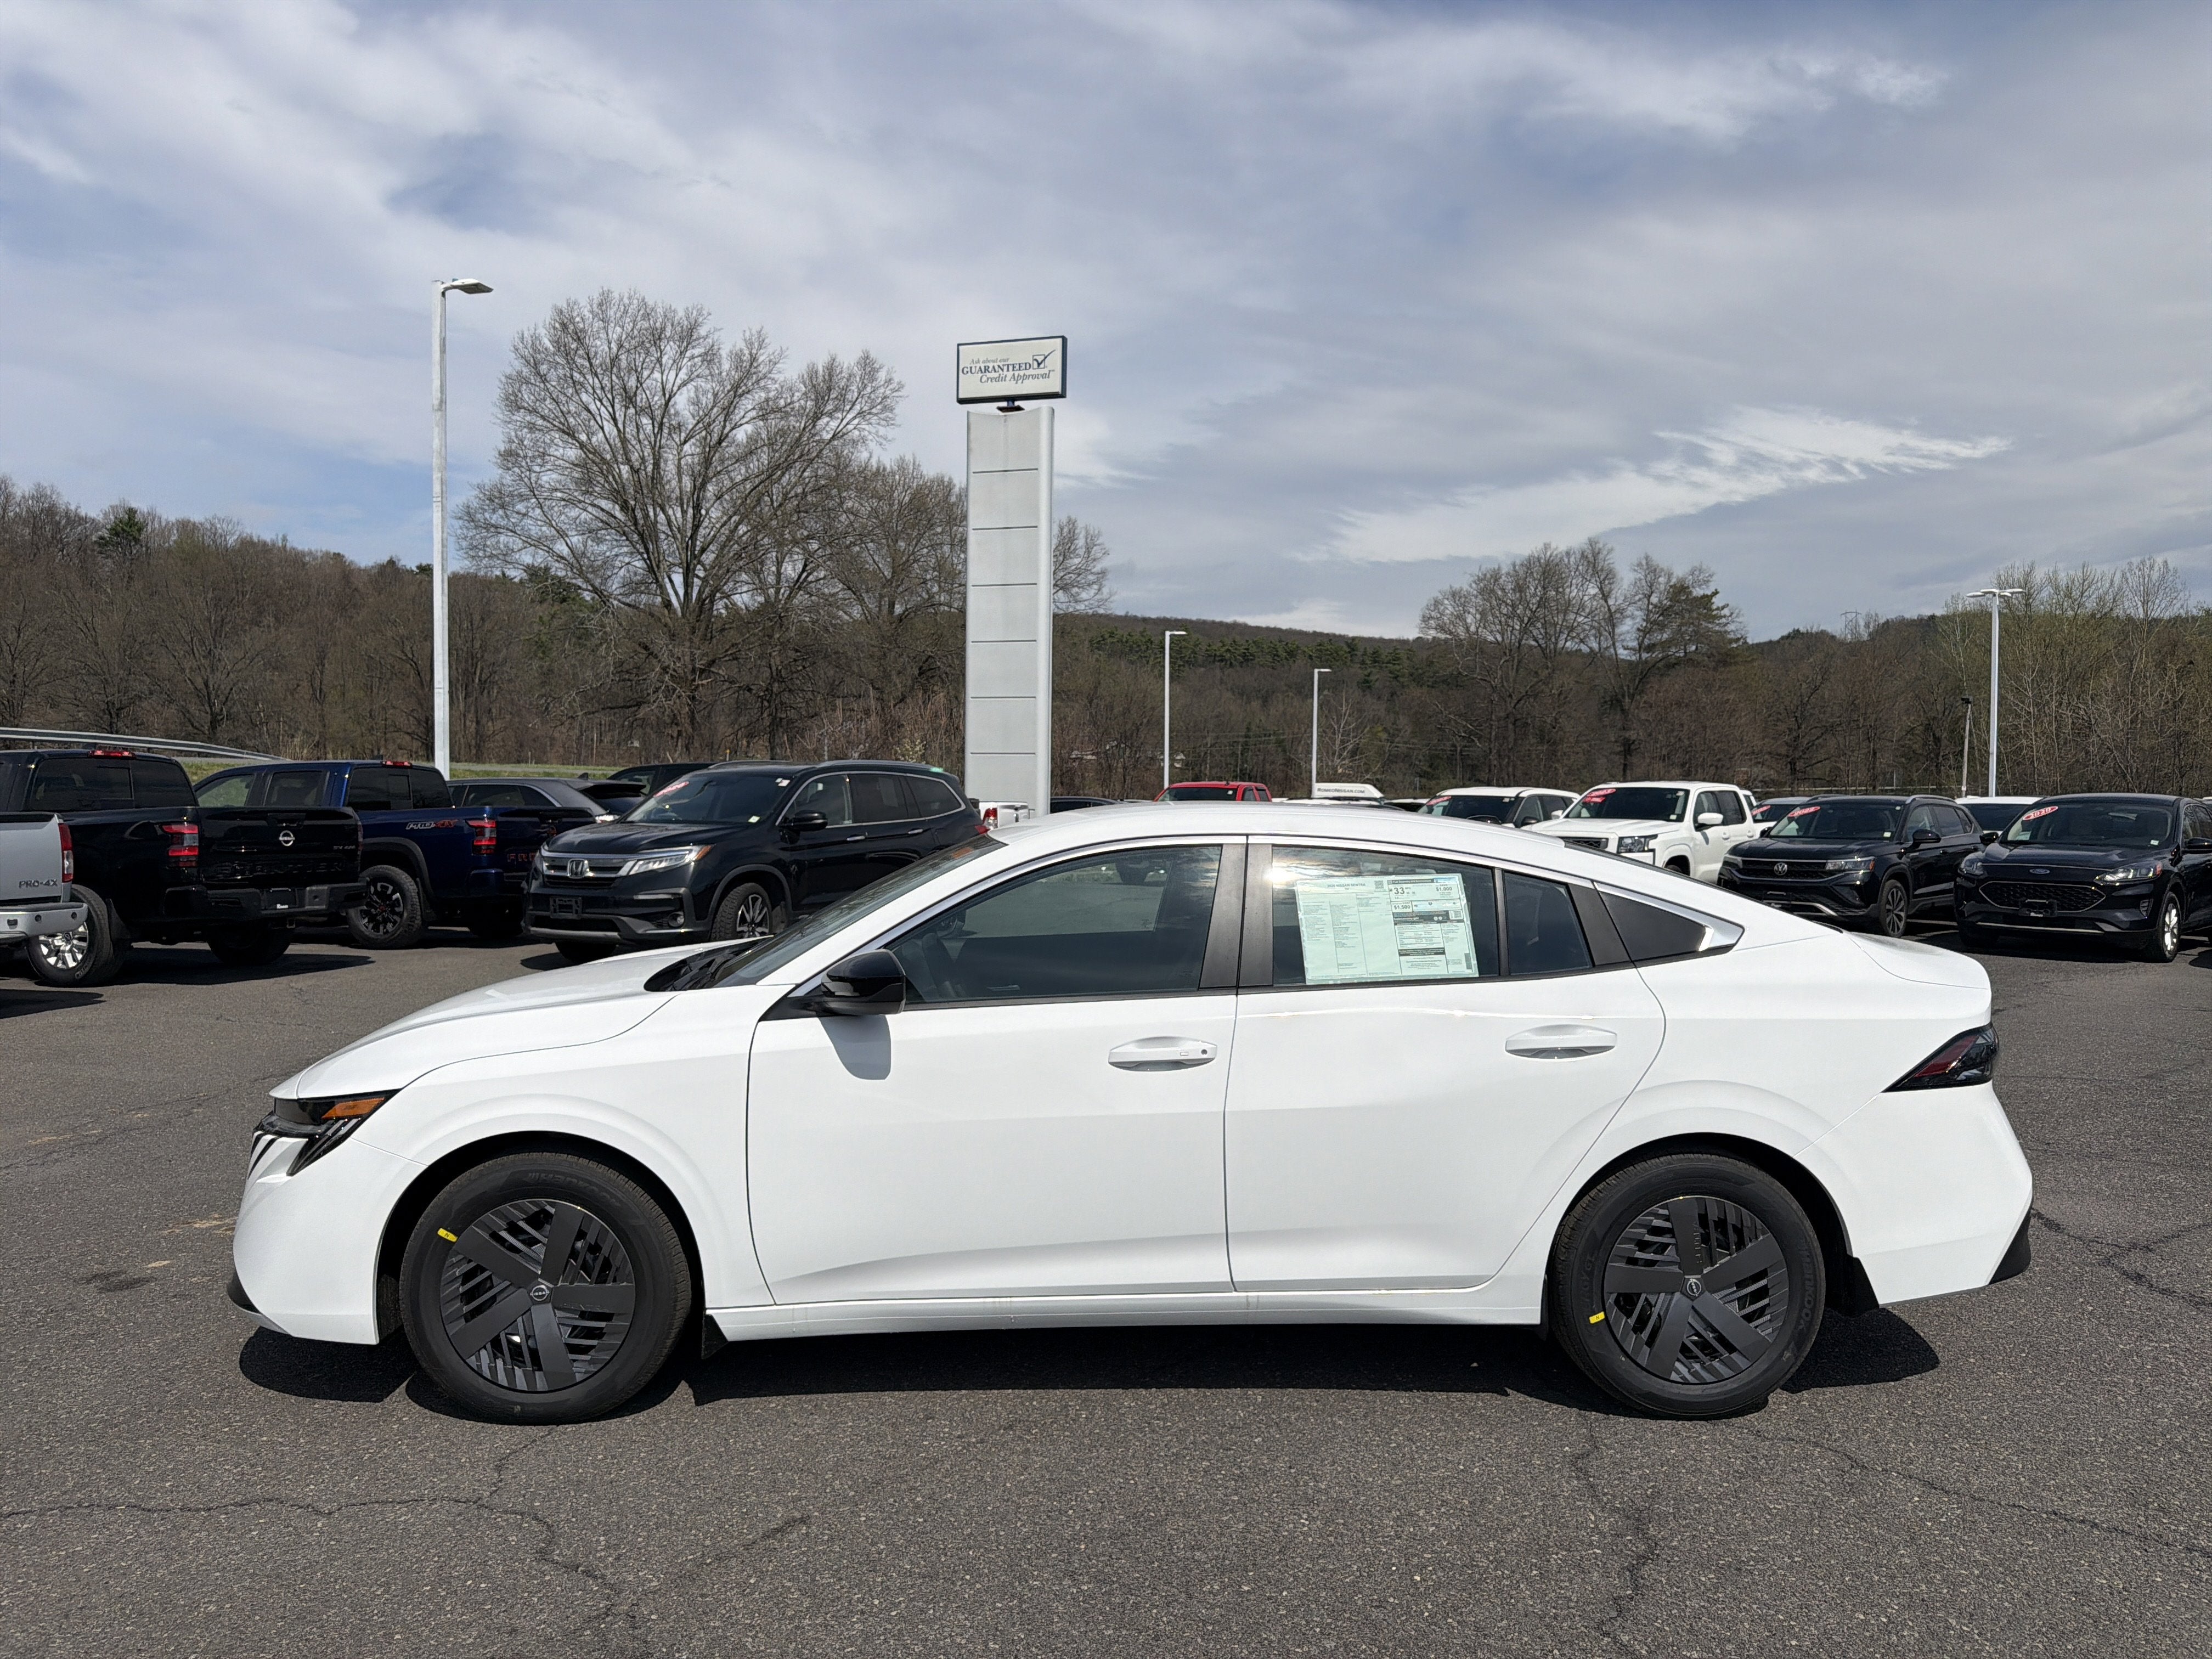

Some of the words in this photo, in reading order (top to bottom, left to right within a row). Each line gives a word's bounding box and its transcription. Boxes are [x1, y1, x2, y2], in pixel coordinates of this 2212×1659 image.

[961, 362, 1031, 375] GUARANTEED
[980, 373, 1007, 383] Credit
[1008, 369, 1051, 385] Approval
[19, 879, 58, 889] PRO-4X
